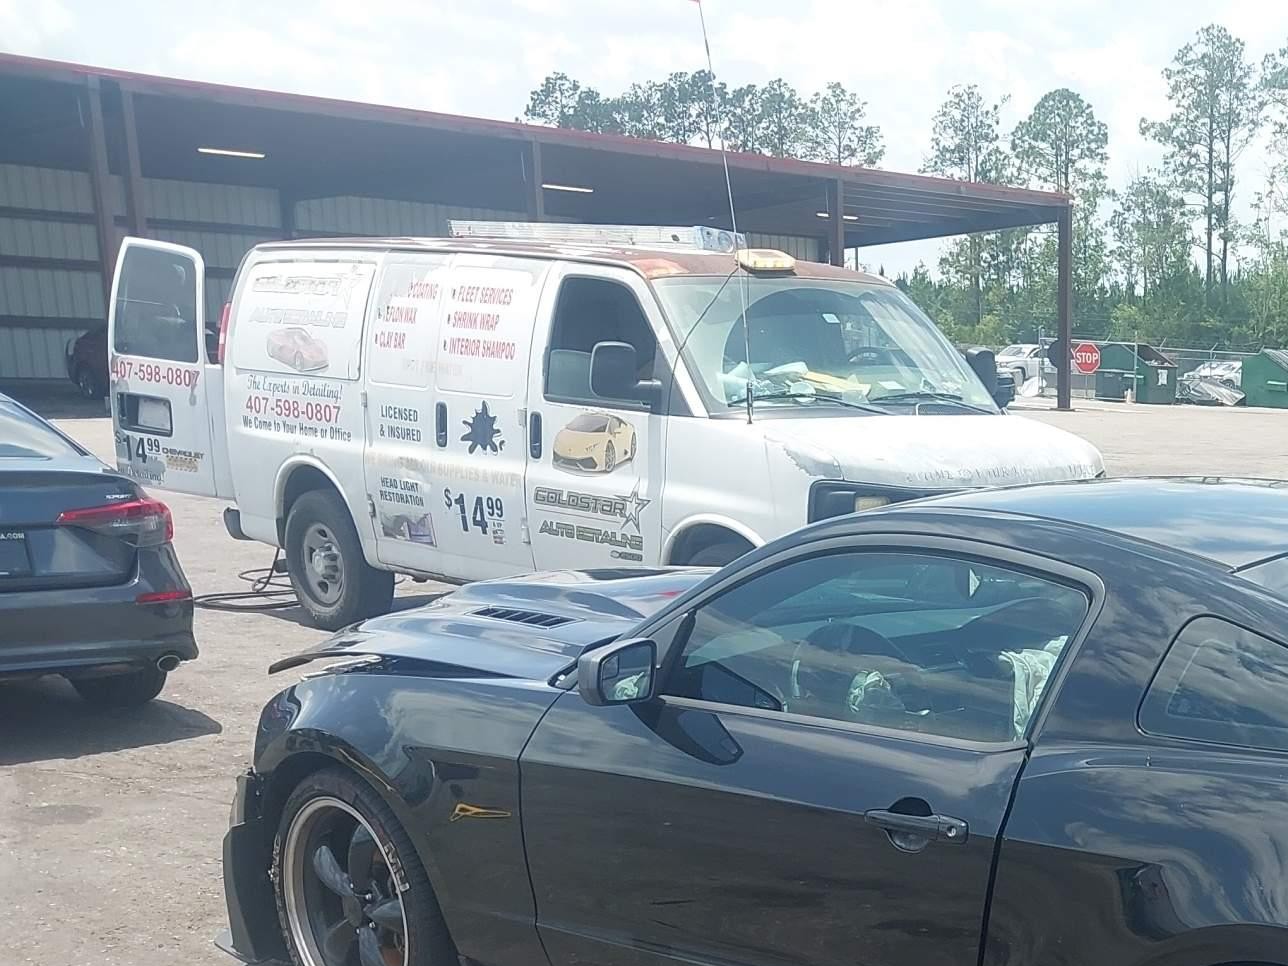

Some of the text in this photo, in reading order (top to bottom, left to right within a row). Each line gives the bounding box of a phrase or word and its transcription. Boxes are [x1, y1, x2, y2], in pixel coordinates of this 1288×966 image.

[457, 286, 514, 306] FLEET SERVICES
[404, 307, 418, 324] WAX
[452, 311, 500, 331] SHRINK WRAP
[379, 331, 406, 349] CLAY BAR
[449, 337, 516, 360] INTERIOR SHAMPOO
[1076, 352, 1098, 364] STOP
[112, 361, 200, 387] 407-598-0807
[247, 374, 343, 404] The Experts in Detailing!
[245, 395, 341, 424] 407-598-0807
[381, 404, 418, 422] LICENSED
[242, 415, 352, 442] We Come to Your Home or Office
[379, 423, 421, 442] & INSURED
[380, 475, 419, 493] HEAD LIGHT
[379, 490, 425, 507] RESTORATION
[539, 519, 575, 539] AUTO
